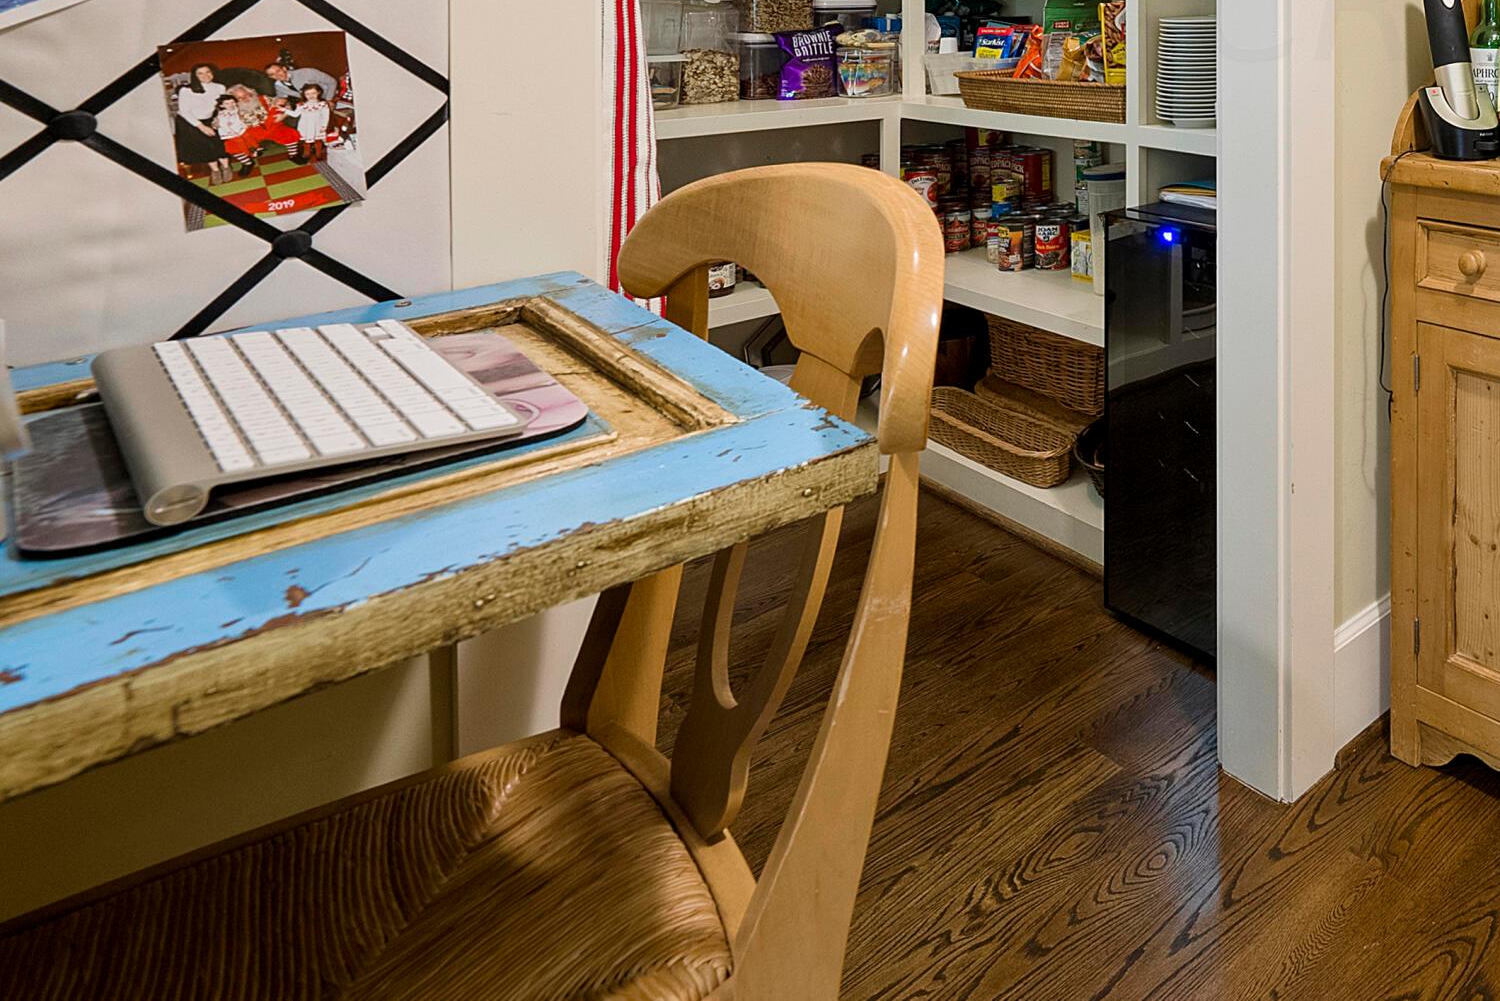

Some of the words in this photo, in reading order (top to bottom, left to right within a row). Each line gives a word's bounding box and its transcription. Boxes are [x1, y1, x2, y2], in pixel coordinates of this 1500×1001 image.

[792, 30, 832, 48] BROWNIE
[794, 42, 834, 57] BRITTLE
[268, 199, 295, 211] 2019
